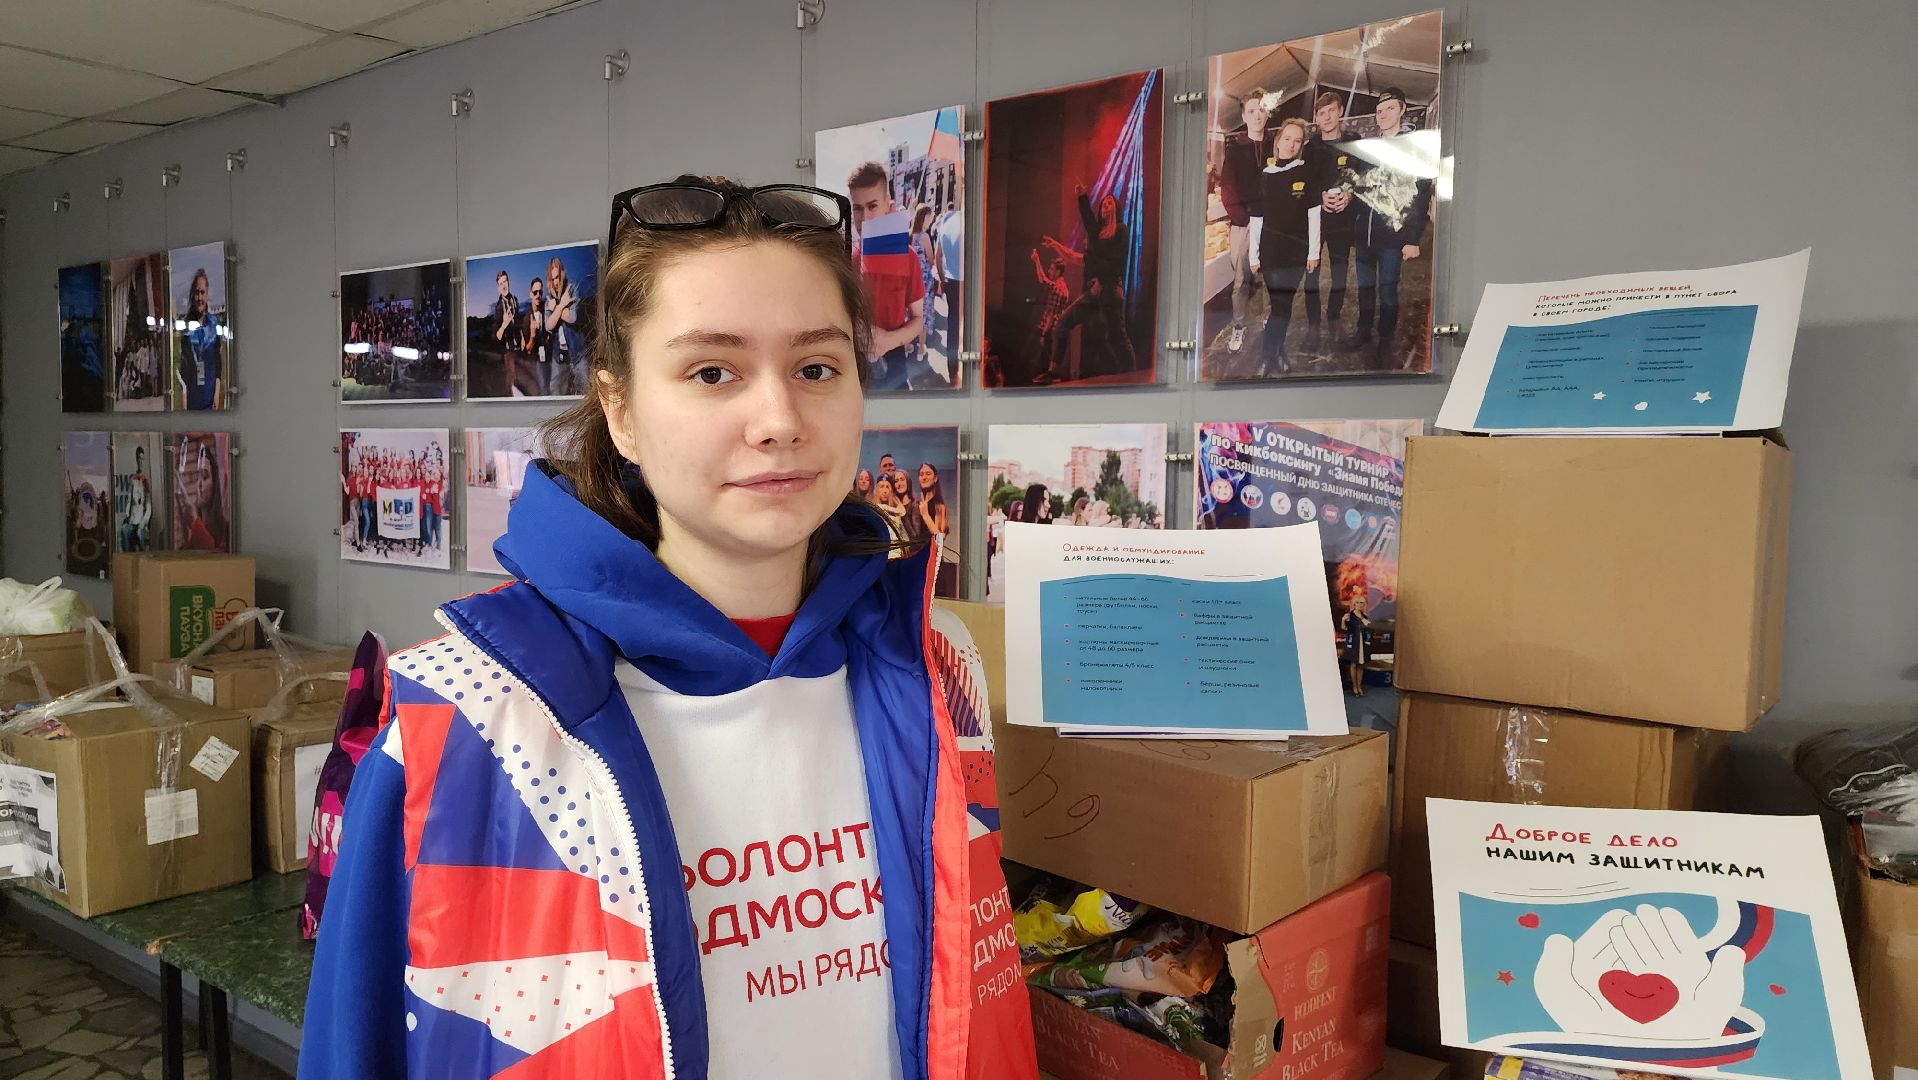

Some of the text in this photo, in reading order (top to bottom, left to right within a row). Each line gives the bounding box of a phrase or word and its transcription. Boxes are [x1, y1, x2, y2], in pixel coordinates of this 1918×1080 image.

[1235, 441, 1321, 476] кикбоксингу
[1328, 467, 1369, 487] «Знамя
[1370, 476, 1403, 497] Побед
[1252, 427, 1389, 478] V ОТКРЫТЫЙ ТУРНИР
[1210, 453, 1296, 484] ПОСВЯЩЕННЫЙ
[1297, 476, 1320, 490] ДНЮ
[1321, 482, 1374, 503] ЗАЩИТНИКА
[180, 606, 191, 652] ПАУЗА
[692, 876, 884, 955] ДМОСК
[747, 960, 806, 1003] МЫ
